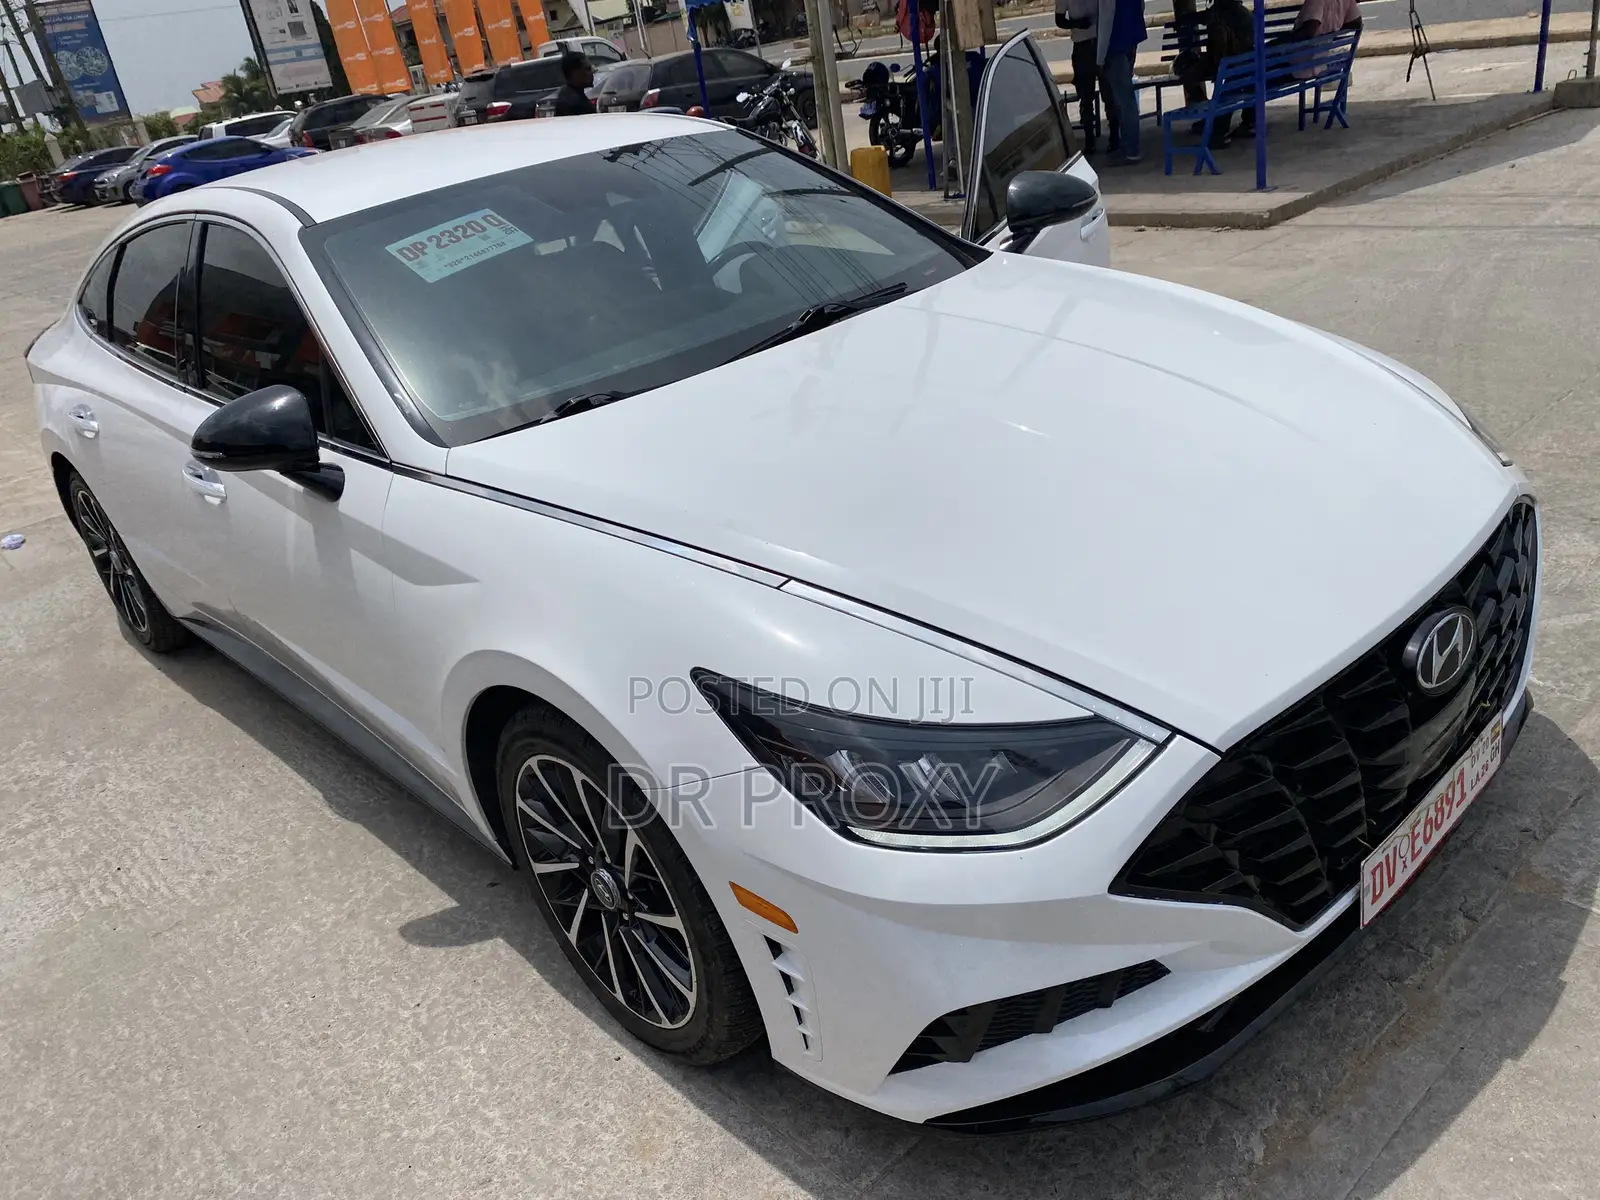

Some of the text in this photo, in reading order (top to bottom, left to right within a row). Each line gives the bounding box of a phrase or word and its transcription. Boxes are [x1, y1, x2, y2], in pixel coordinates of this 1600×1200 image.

[395, 214, 507, 262] DP 2320 Q
[1370, 846, 1398, 906] DV
[1410, 767, 1467, 862] E6891
